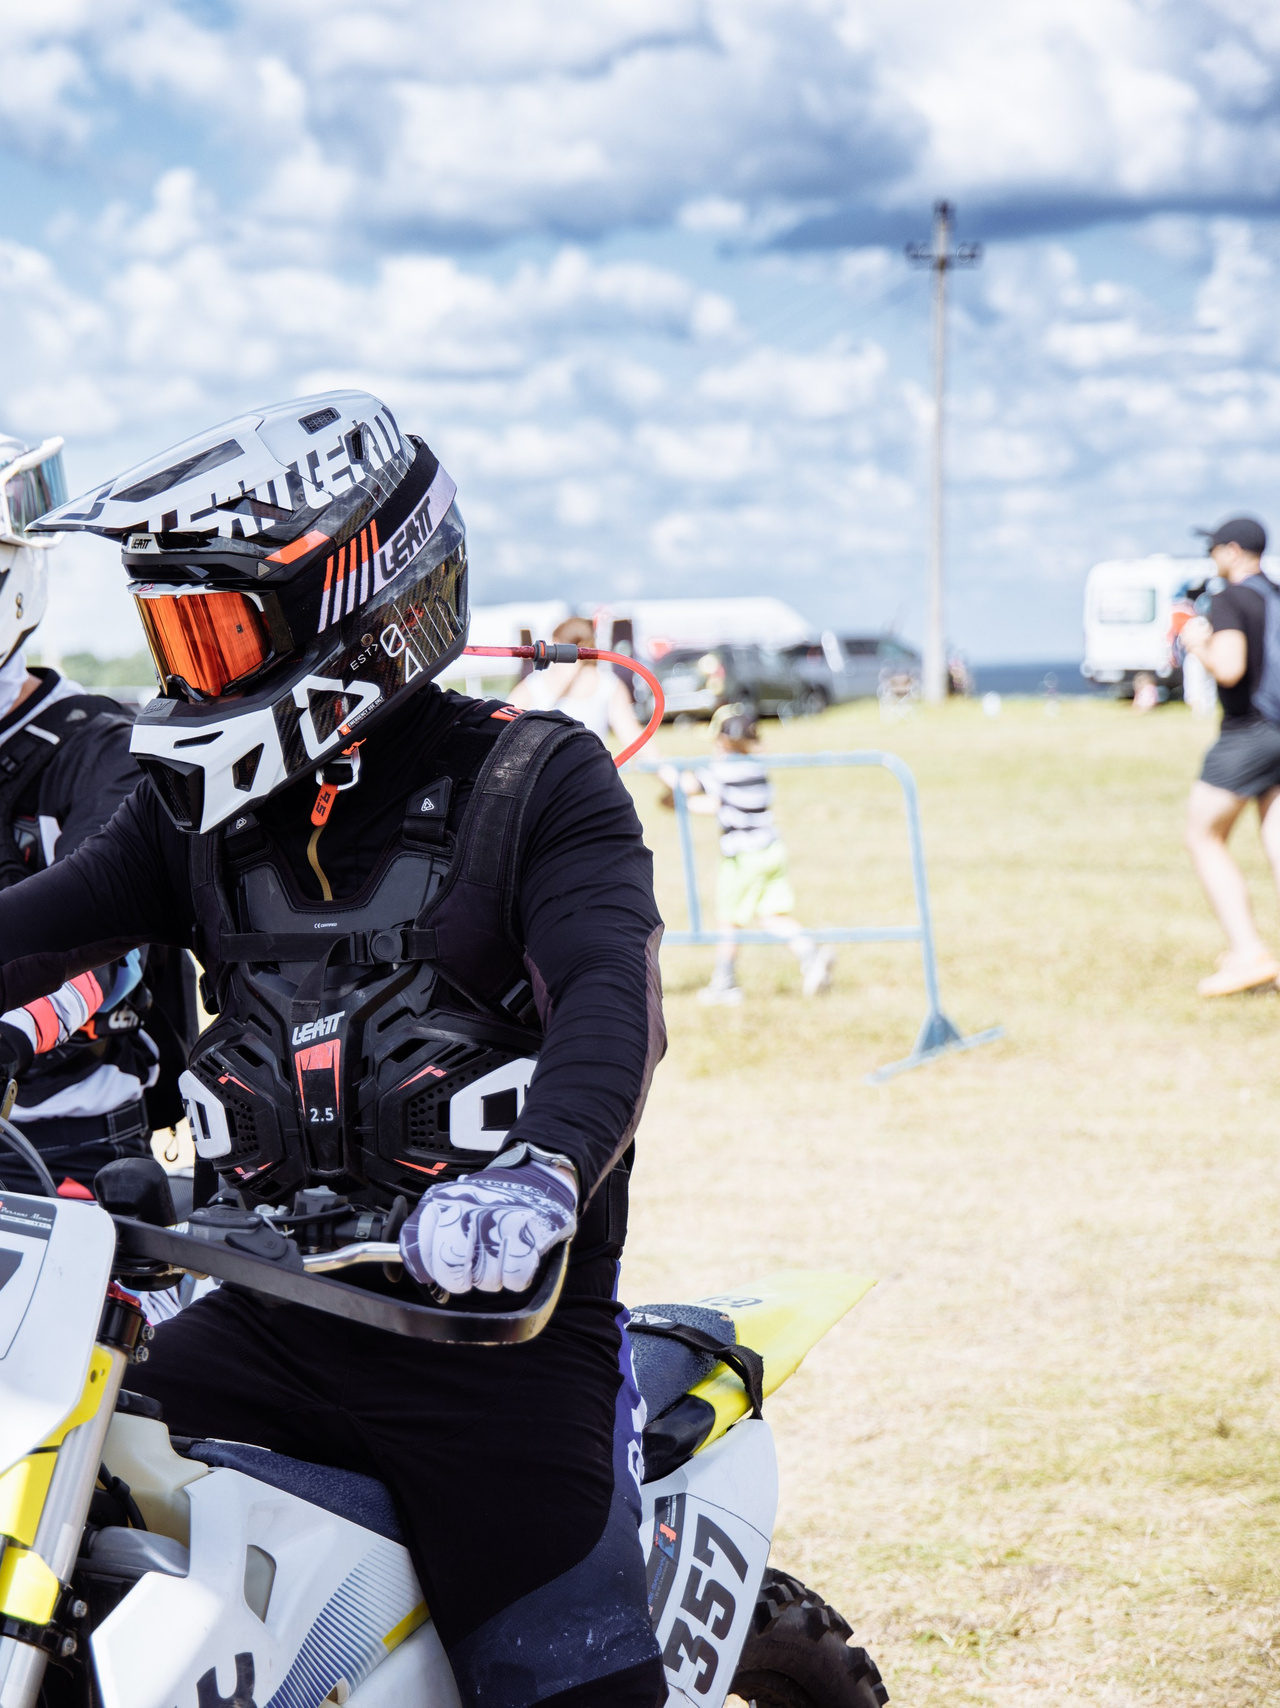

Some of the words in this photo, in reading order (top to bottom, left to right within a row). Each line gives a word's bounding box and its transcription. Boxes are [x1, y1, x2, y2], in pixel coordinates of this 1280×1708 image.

[379, 495, 434, 581] LEATT
[292, 1010, 345, 1045] LEATT
[310, 1107, 334, 1122] 2.5
[663, 1513, 749, 1695] 357
